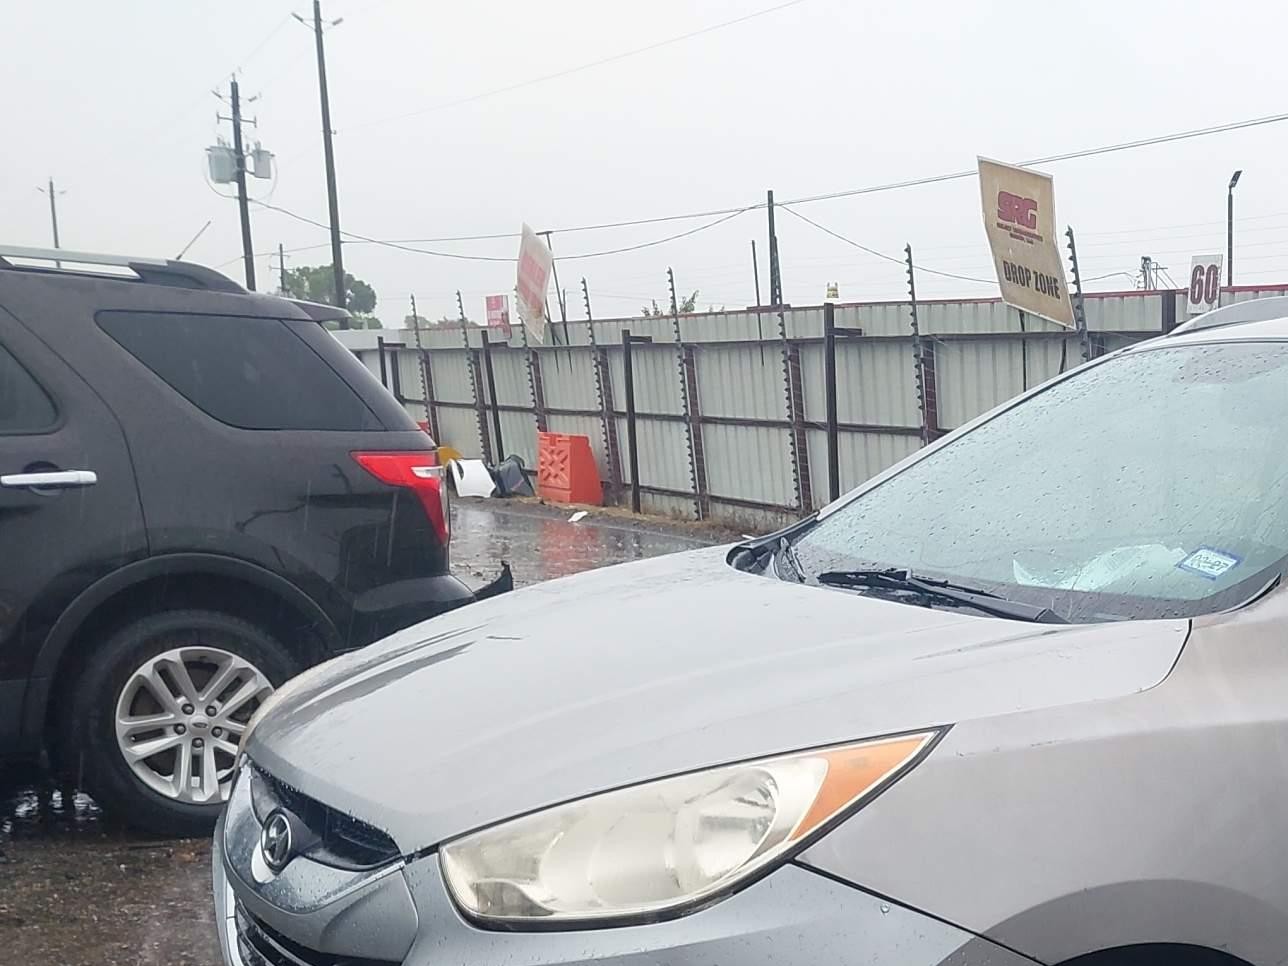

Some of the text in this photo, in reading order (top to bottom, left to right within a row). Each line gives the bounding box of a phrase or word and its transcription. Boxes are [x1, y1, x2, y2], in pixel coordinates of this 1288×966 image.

[997, 190, 1038, 230] SRG
[1002, 259, 1060, 300] DROP ZONE
[1190, 264, 1218, 304] 60
